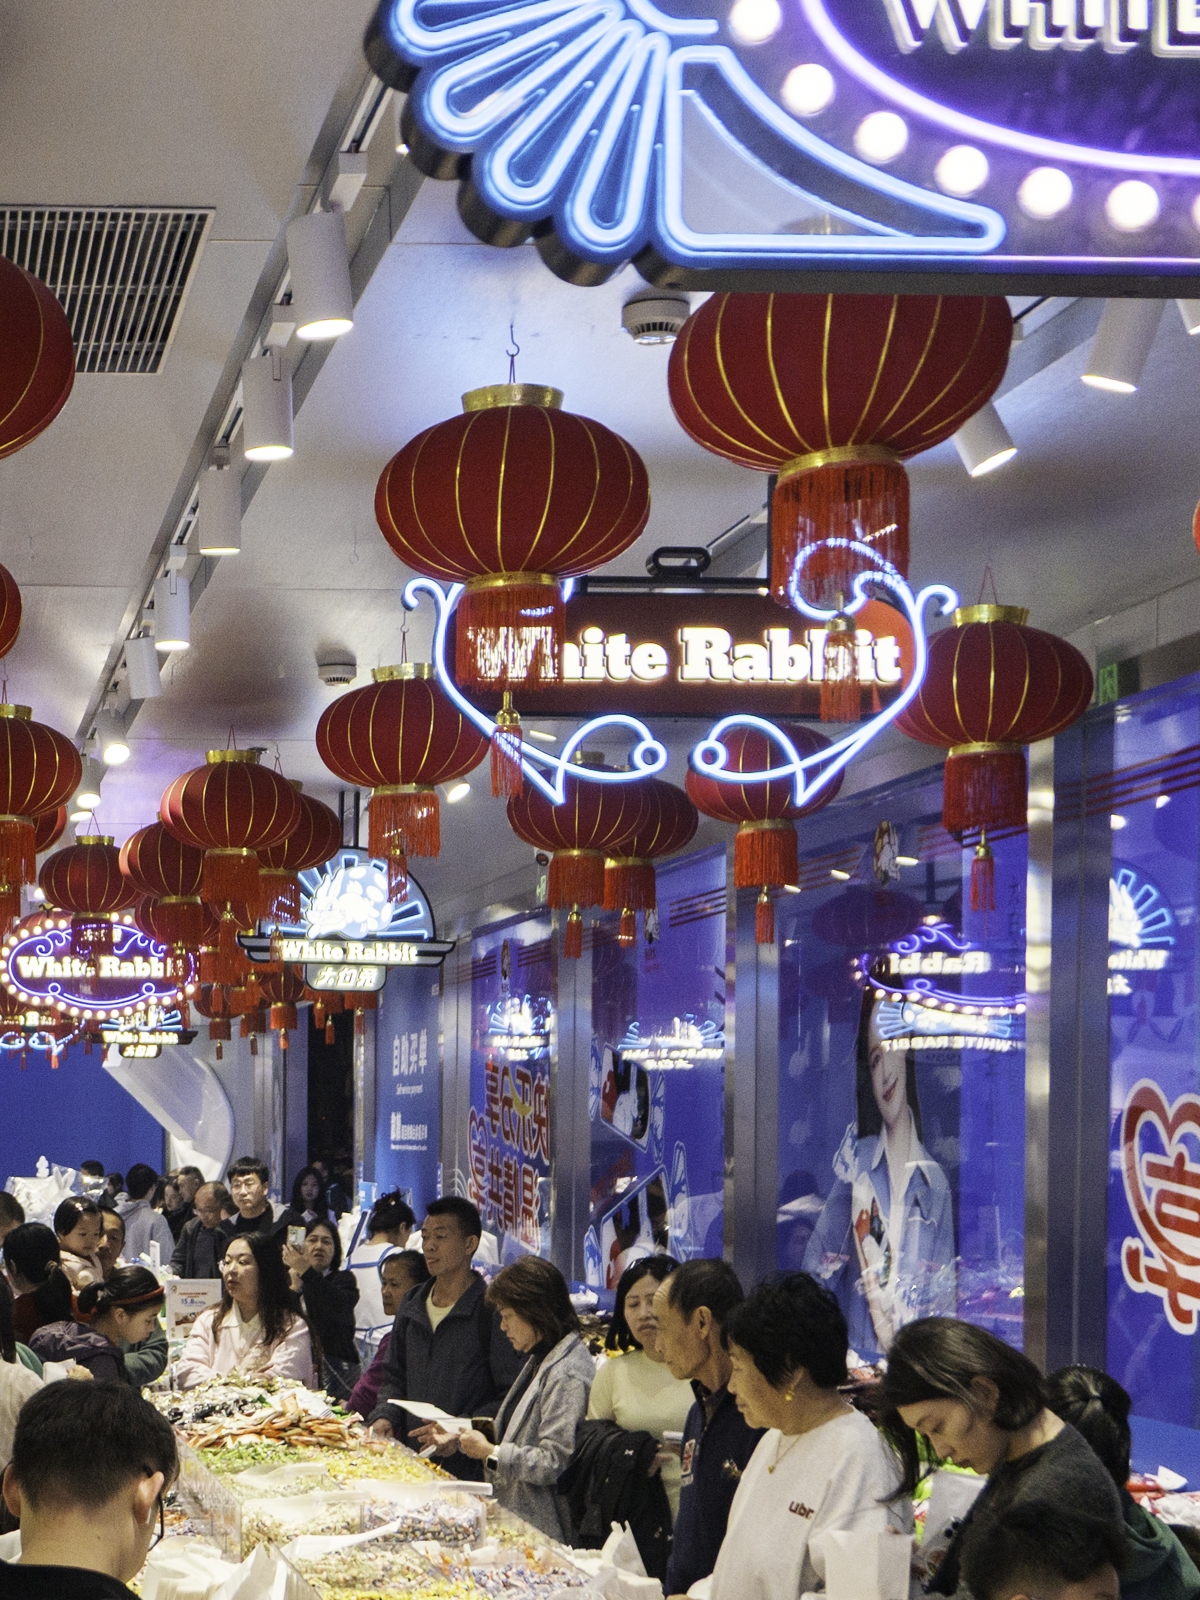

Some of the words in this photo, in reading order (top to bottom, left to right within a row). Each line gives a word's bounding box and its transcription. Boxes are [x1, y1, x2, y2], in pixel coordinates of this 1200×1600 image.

[346, 942, 418, 962] Rabbit
[316, 966, 378, 988] 大白兔
